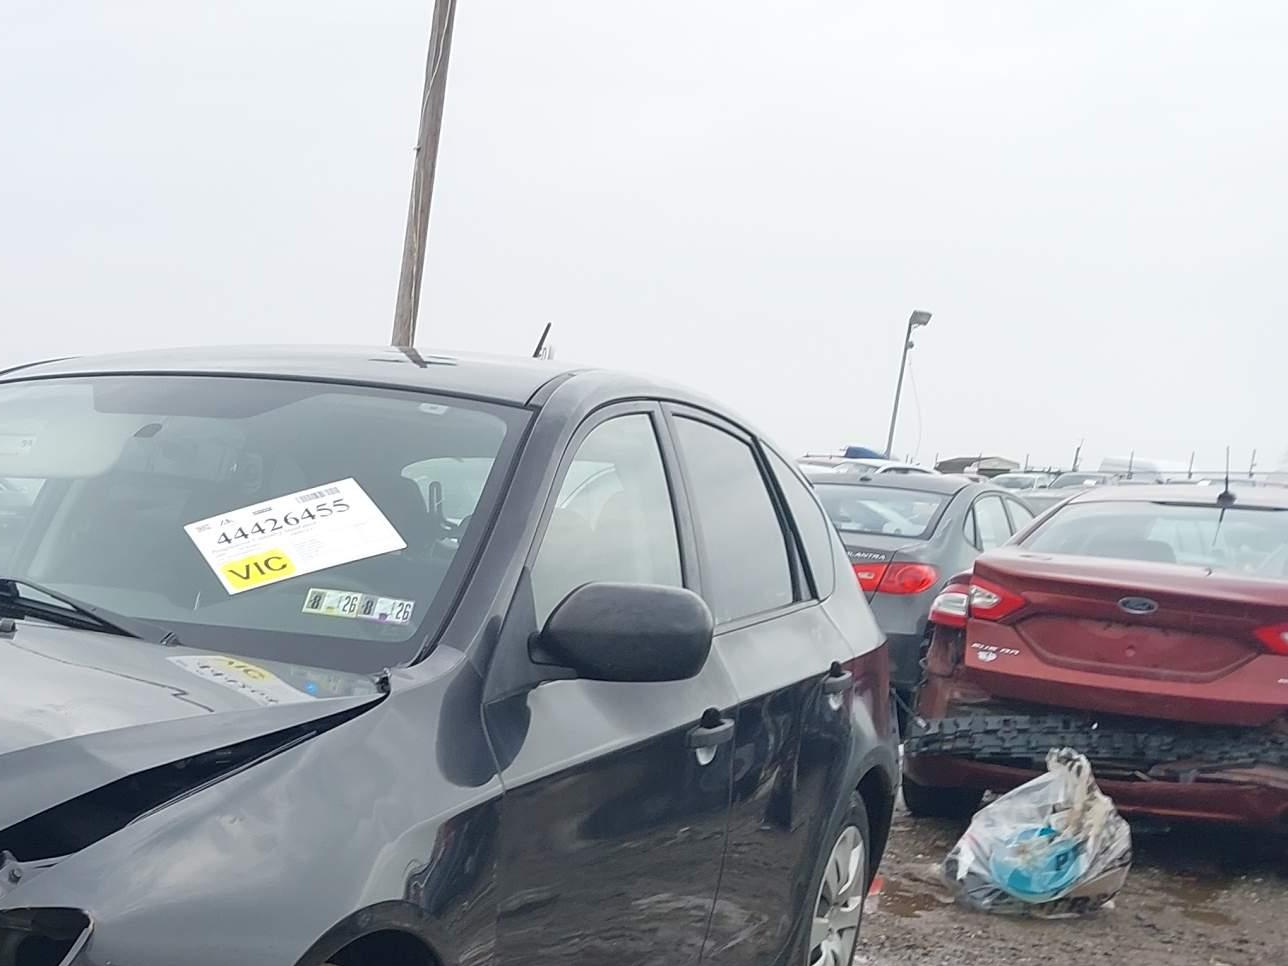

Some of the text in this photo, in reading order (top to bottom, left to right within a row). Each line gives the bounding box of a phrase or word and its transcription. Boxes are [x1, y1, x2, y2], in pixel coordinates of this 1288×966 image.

[216, 498, 351, 545] 44426455
[227, 555, 288, 581] VIC
[342, 595, 359, 614] 26
[395, 602, 412, 621] 26
